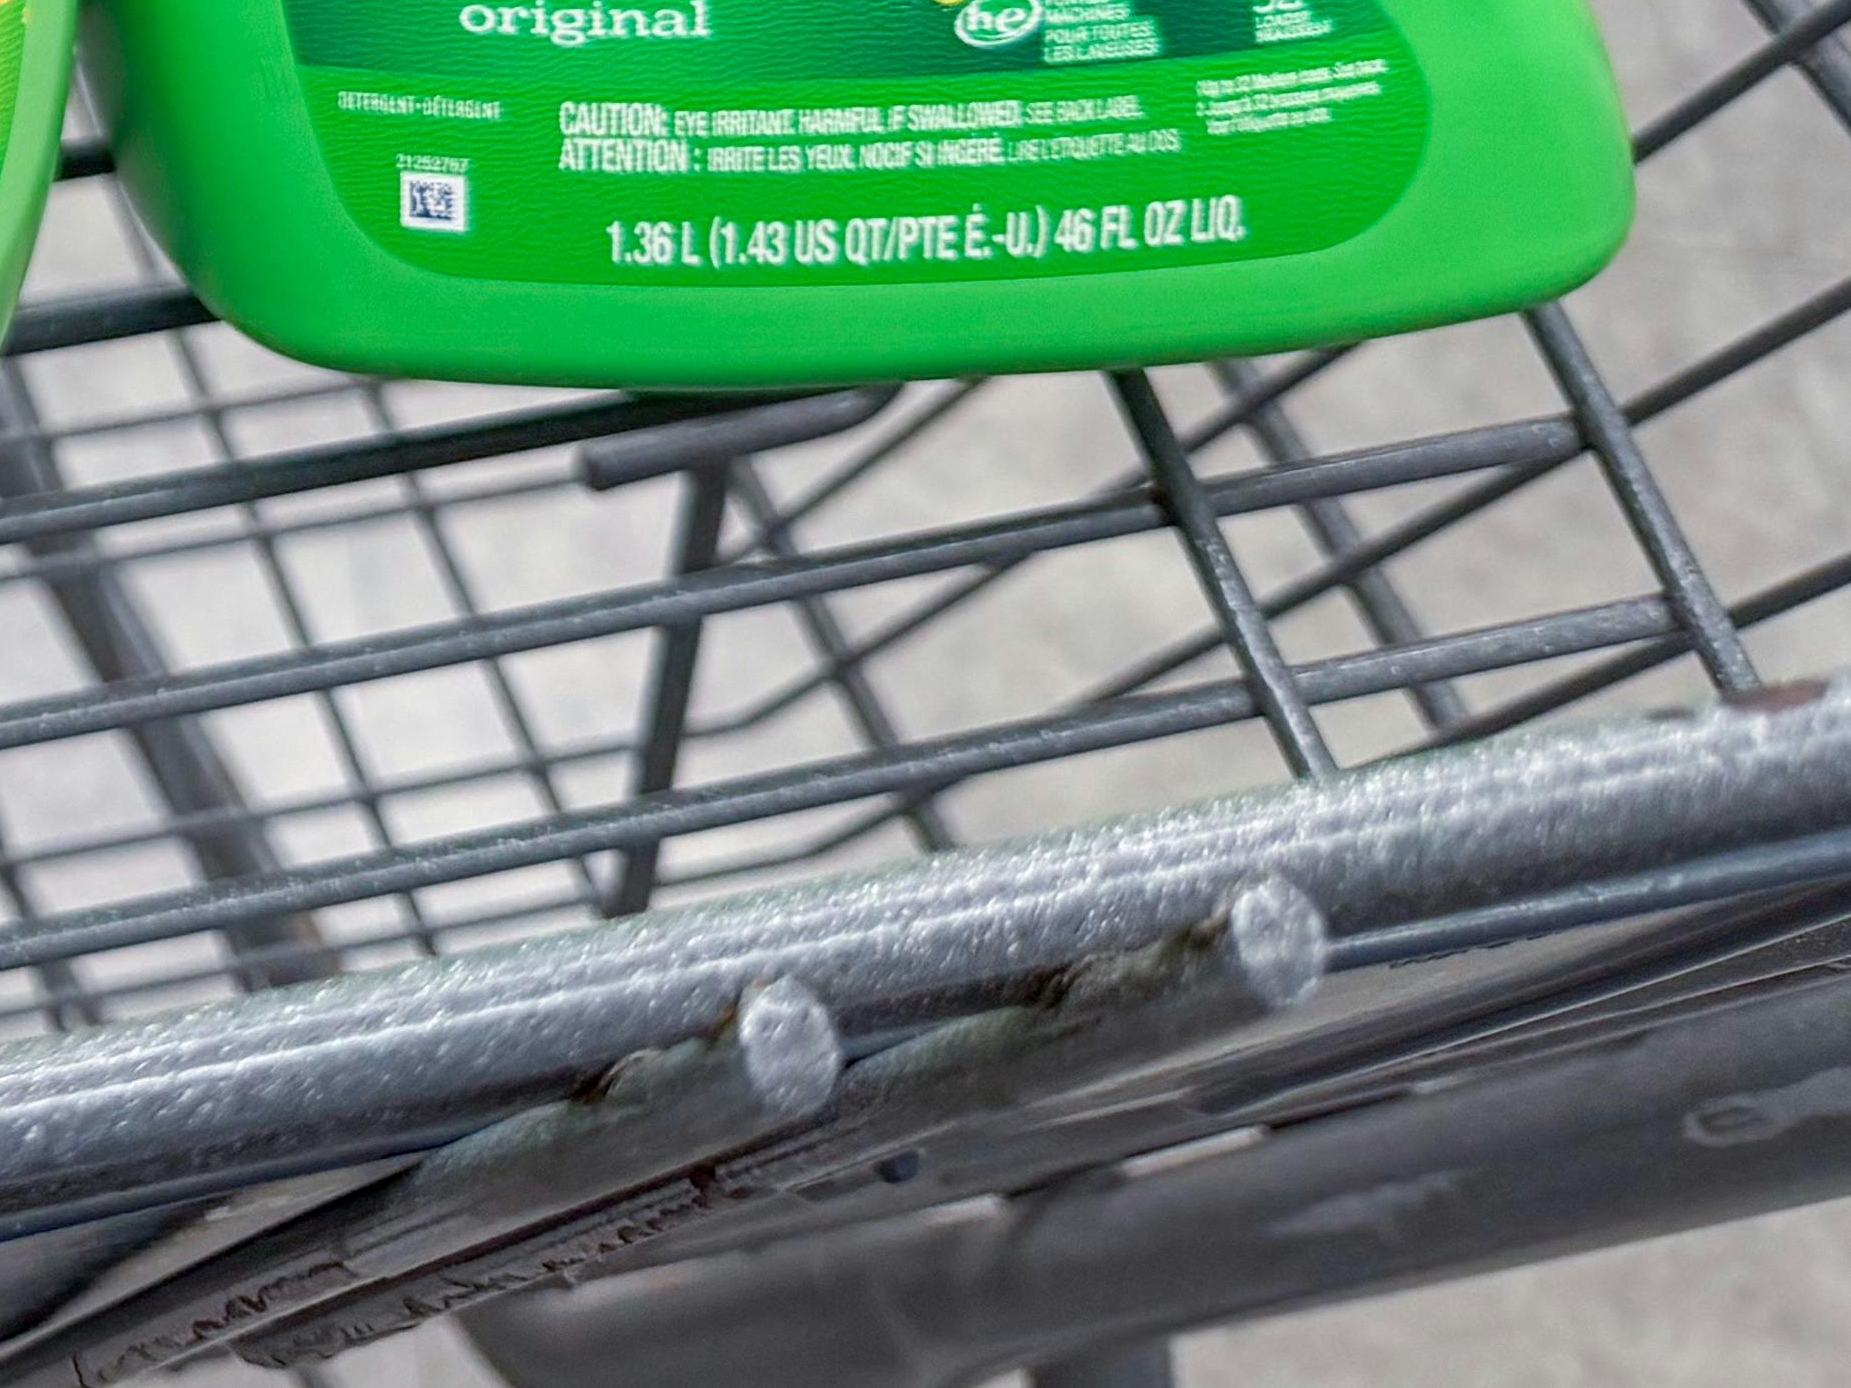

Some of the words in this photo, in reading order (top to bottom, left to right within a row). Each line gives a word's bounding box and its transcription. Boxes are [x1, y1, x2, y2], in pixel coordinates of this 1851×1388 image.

[460, 0, 714, 47] original
[559, 101, 668, 137] CAUTION:
[674, 110, 709, 136] EYE
[559, 137, 689, 172] ATTENTION
[767, 145, 801, 171] LES
[606, 220, 675, 265] 1.36
[681, 221, 702, 265] L
[709, 216, 789, 269] (1.43
[794, 218, 840, 265] US
[845, 213, 959, 266] QT/PTE
[1054, 208, 1096, 253] 46
[1099, 204, 1139, 250] FL
[1144, 199, 1188, 247] OZ
[1190, 194, 1247, 242] LIQ.
